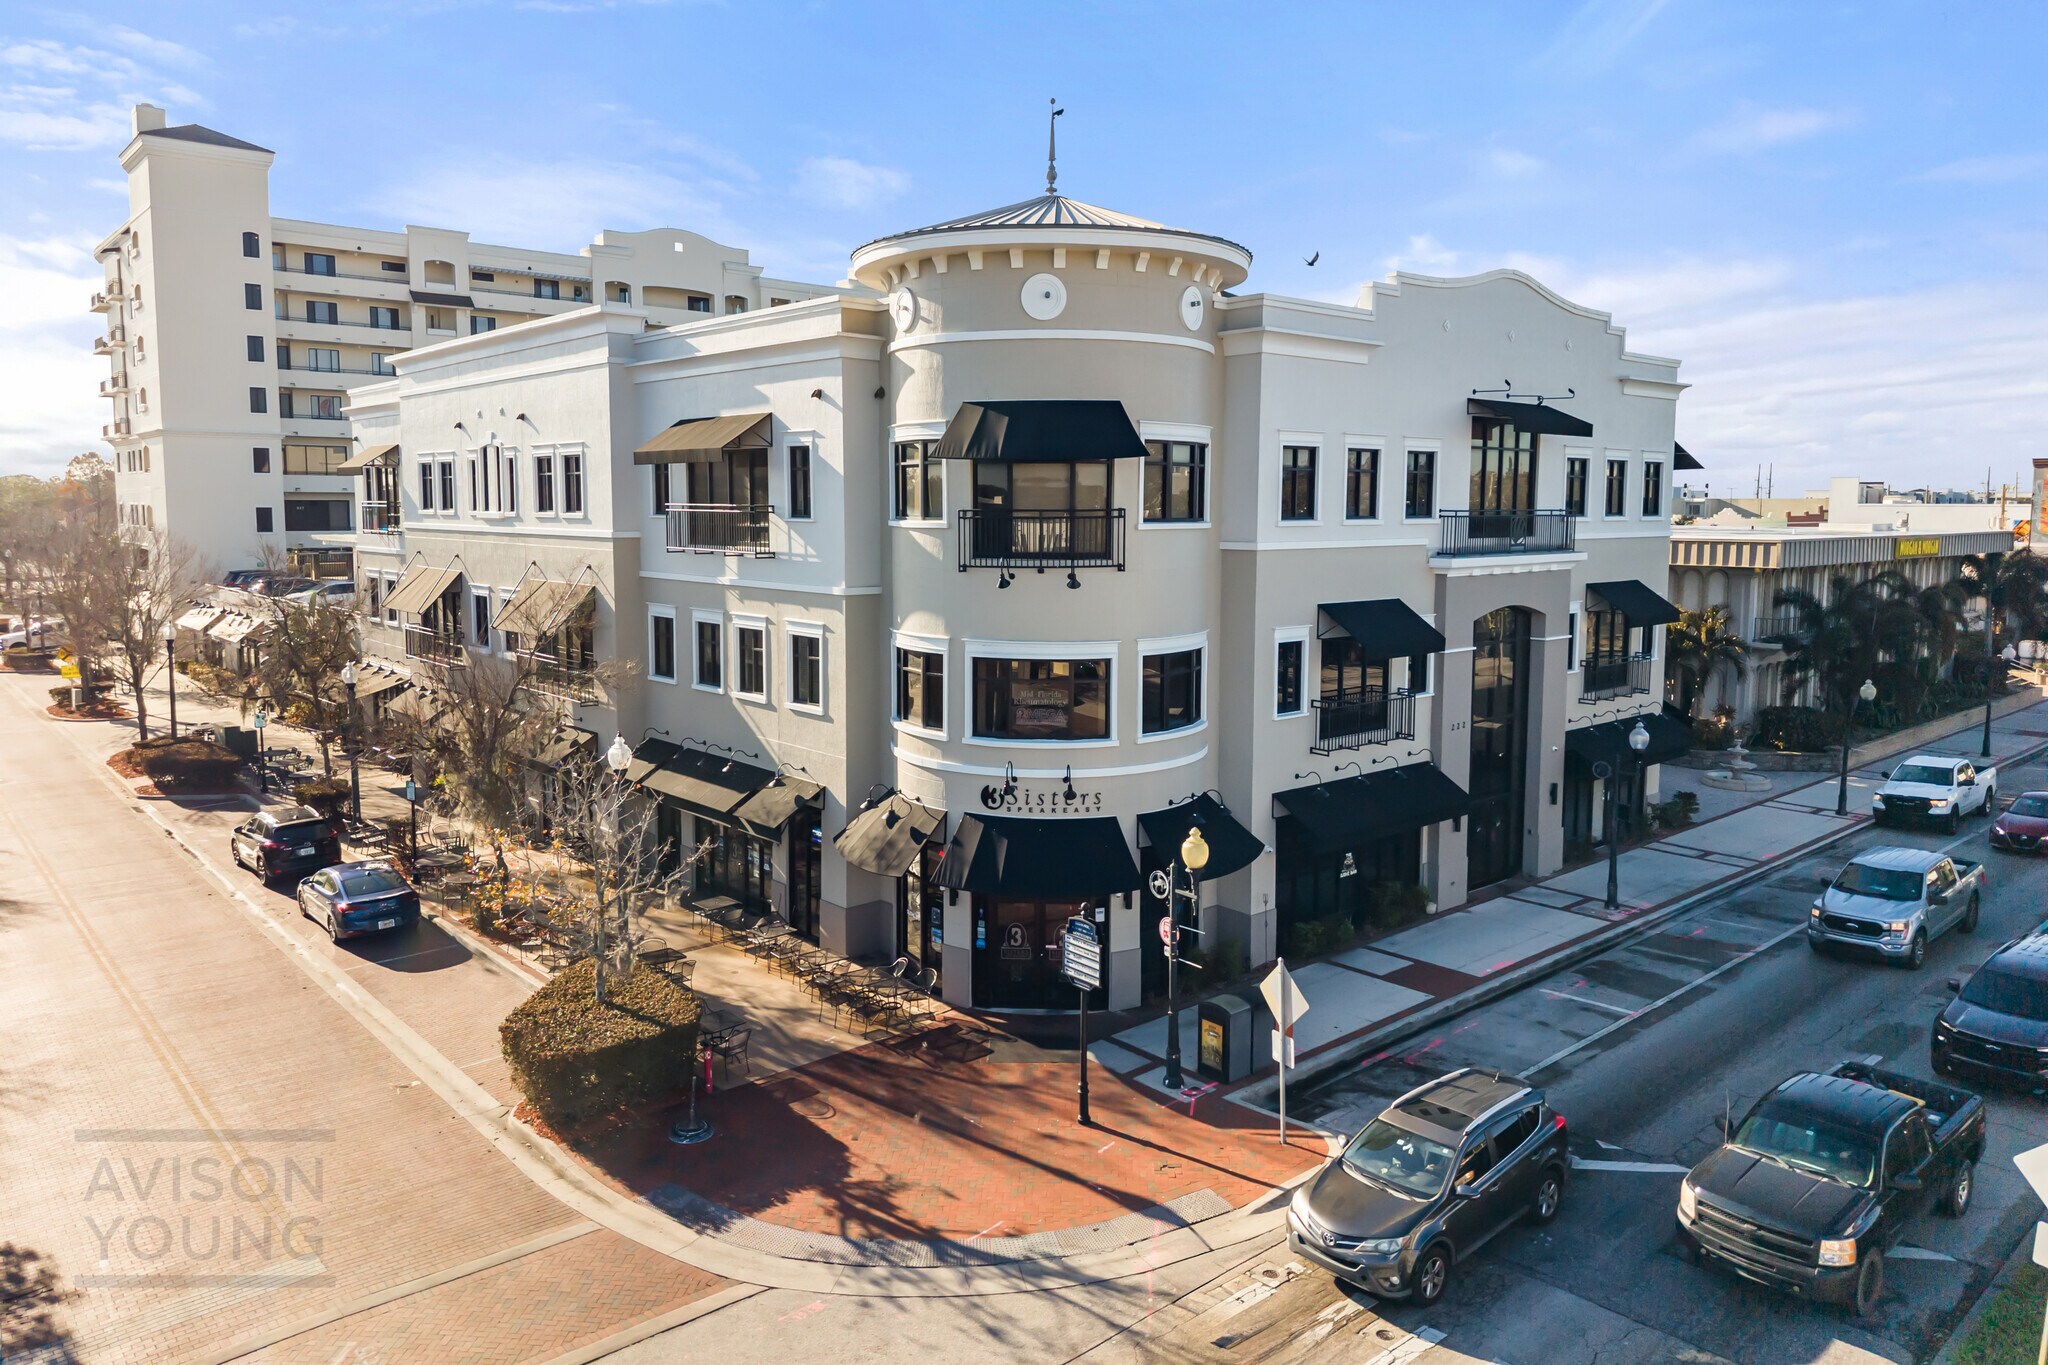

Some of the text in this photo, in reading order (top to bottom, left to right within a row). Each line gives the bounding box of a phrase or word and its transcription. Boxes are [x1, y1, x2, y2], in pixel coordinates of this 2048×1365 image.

[1900, 541, 1917, 555] MORGAN
[1923, 540, 1939, 554] MORGAN
[1014, 698, 1066, 707] Rheumatology
[1006, 806, 1102, 814] SPEAKEASY
[1011, 927, 1022, 946] 3
